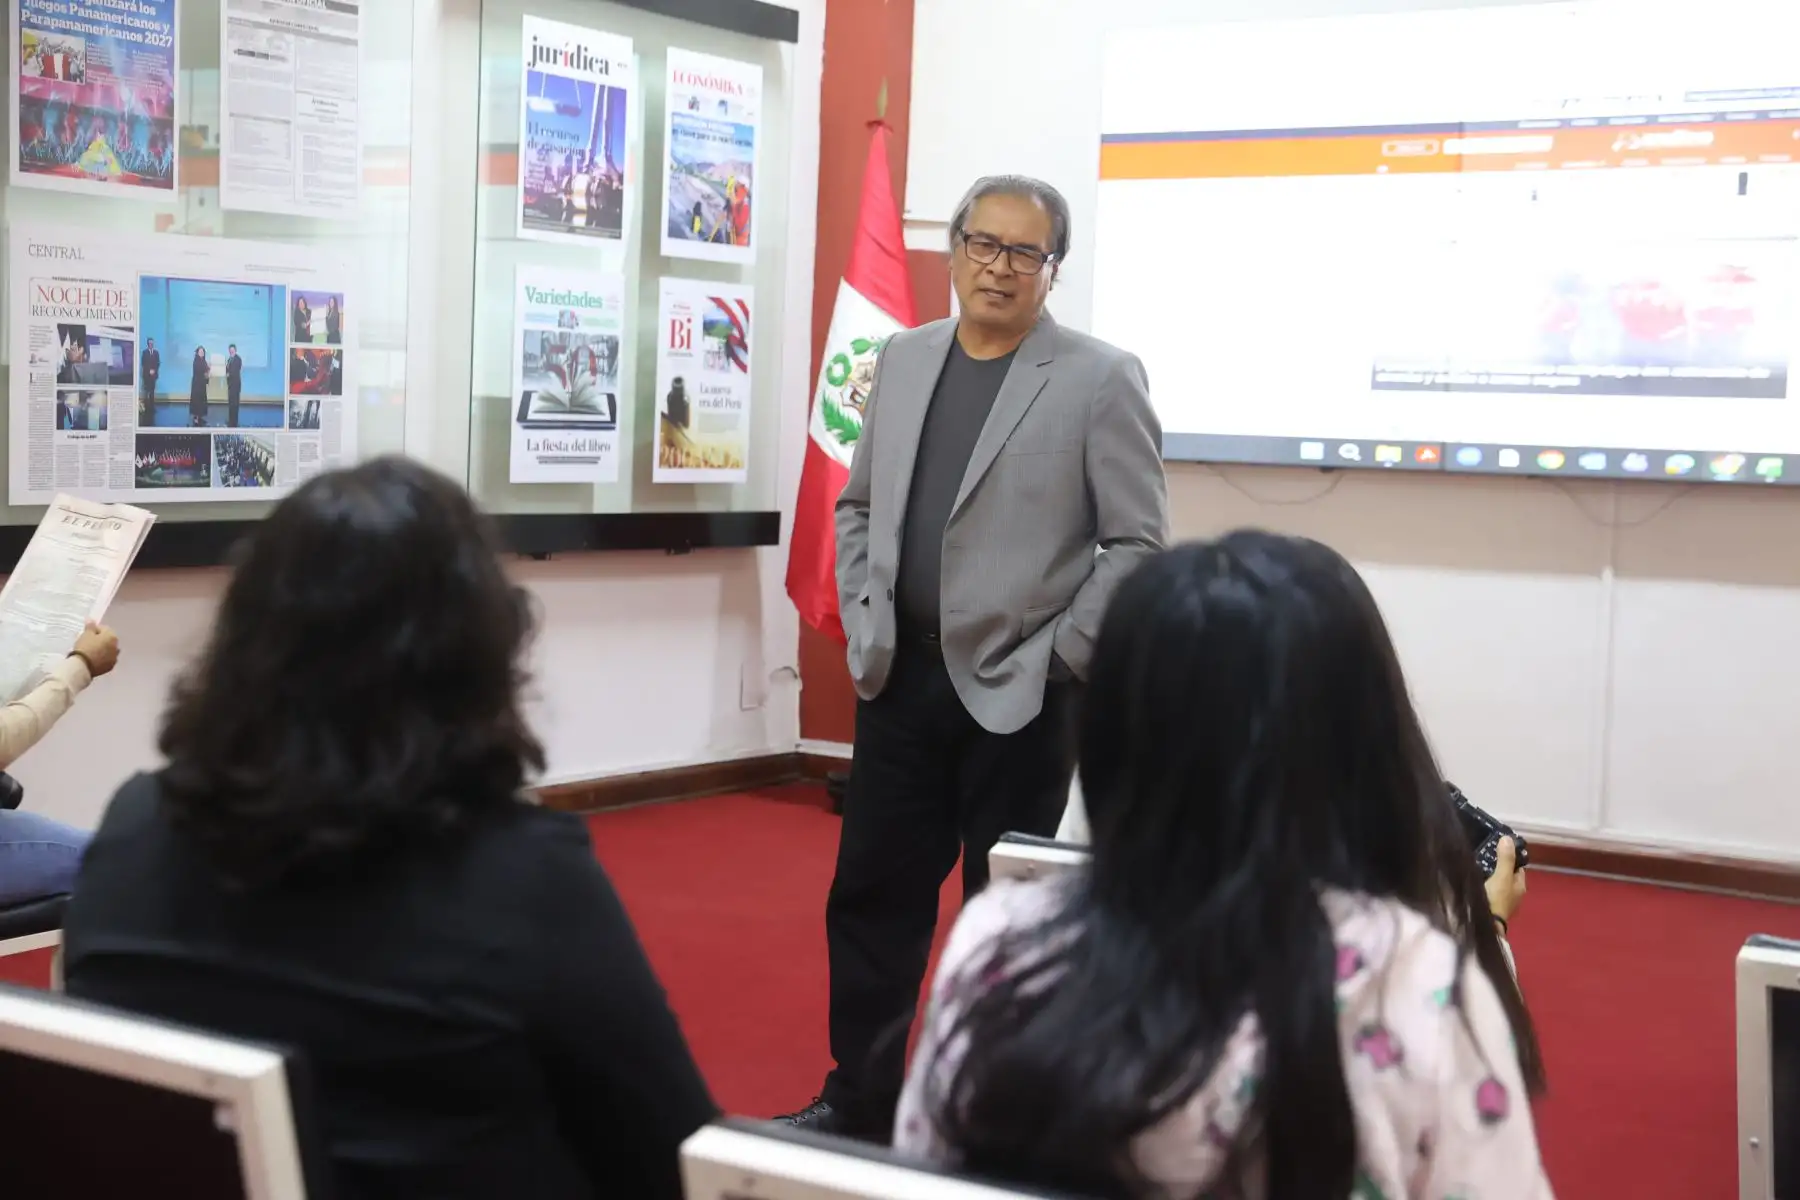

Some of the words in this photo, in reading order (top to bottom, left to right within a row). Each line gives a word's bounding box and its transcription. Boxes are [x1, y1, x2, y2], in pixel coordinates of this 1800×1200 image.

[24, 0, 67, 14] Juegos
[69, 3, 160, 30] Panamericanos
[162, 23, 171, 35] y
[139, 1, 157, 16] los
[21, 9, 143, 42] Parapanamericanos
[145, 32, 173, 48] 2027
[527, 35, 609, 76] jurídica
[28, 244, 85, 260] CENTRAL
[38, 284, 102, 306] NOCHE
[106, 289, 129, 309] DE
[525, 285, 603, 309] Variedades
[32, 304, 133, 322] RECONOCIMIENTO
[670, 317, 692, 350] Bi
[712, 398, 724, 408] del
[527, 438, 539, 452] La
[542, 438, 568, 452] fiesta
[571, 438, 586, 452] del
[588, 438, 611, 452] libro
